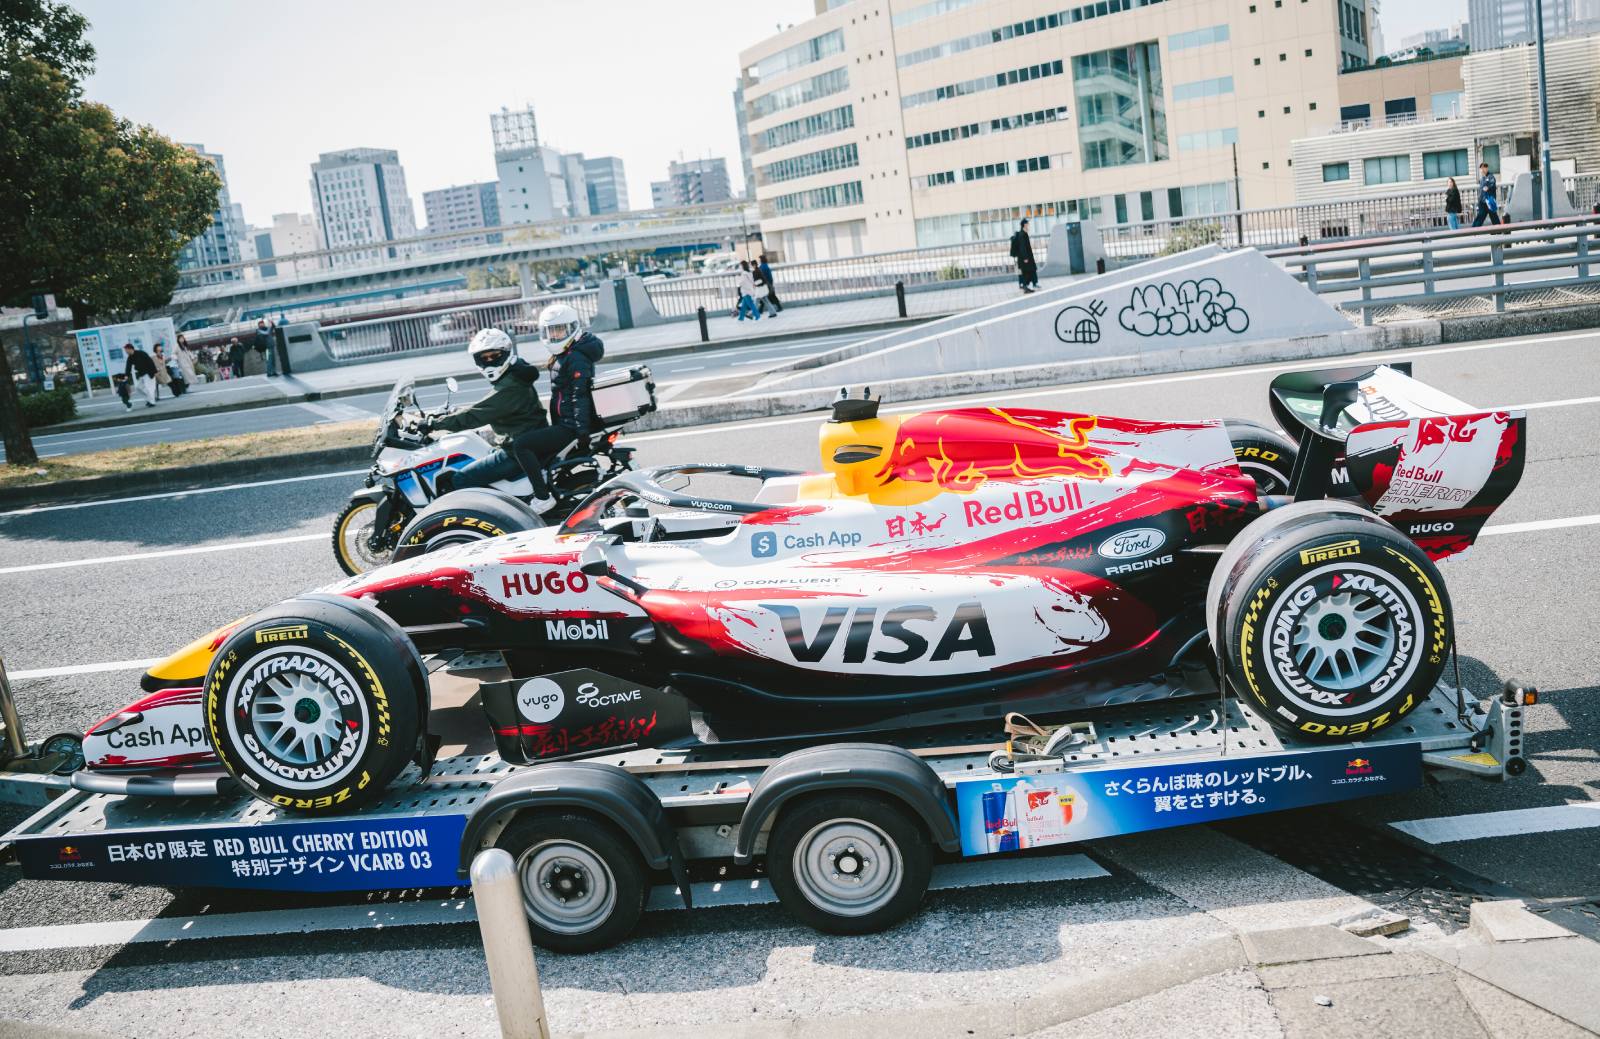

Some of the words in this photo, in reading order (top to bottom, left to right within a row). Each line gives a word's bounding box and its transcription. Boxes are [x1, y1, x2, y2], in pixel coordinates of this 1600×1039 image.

[1414, 466, 1444, 484] Bull
[1387, 478, 1477, 502] CHERRY
[962, 491, 1024, 528] Red
[1024, 482, 1083, 517] Bull
[442, 516, 457, 527] P
[1409, 521, 1455, 534] HUGO
[783, 532, 824, 549] Cash
[828, 530, 862, 547] App
[1113, 533, 1152, 555] Ford
[1300, 539, 1361, 566] PIRELLI
[1105, 554, 1174, 576] RACING
[501, 570, 589, 598] HUGO
[743, 577, 842, 587] CONFLUENT
[255, 624, 309, 644] PIRELLI
[545, 619, 609, 641] Mobil
[758, 602, 996, 664] VISA
[237, 655, 355, 715] XMTRADING
[522, 693, 559, 710] yugo
[588, 689, 642, 708] OCTAVE
[1398, 693, 1415, 715] P
[1299, 710, 1392, 736] ZERO
[106, 725, 165, 749] Cash
[243, 726, 360, 781] XMTRADING
[357, 769, 371, 790] P
[1104, 764, 1314, 797] さくらんぼ味のレッドブル、
[271, 786, 353, 809] ZERO
[1153, 788, 1267, 813] 翼をさずける。
[213, 837, 245, 857] RED
[250, 835, 289, 855] BULL
[291, 831, 354, 853] CHERRY
[360, 828, 429, 850] EDITION
[231, 855, 345, 878] 特別デザイン
[347, 853, 406, 873] VCARB
[409, 851, 433, 869] 03
